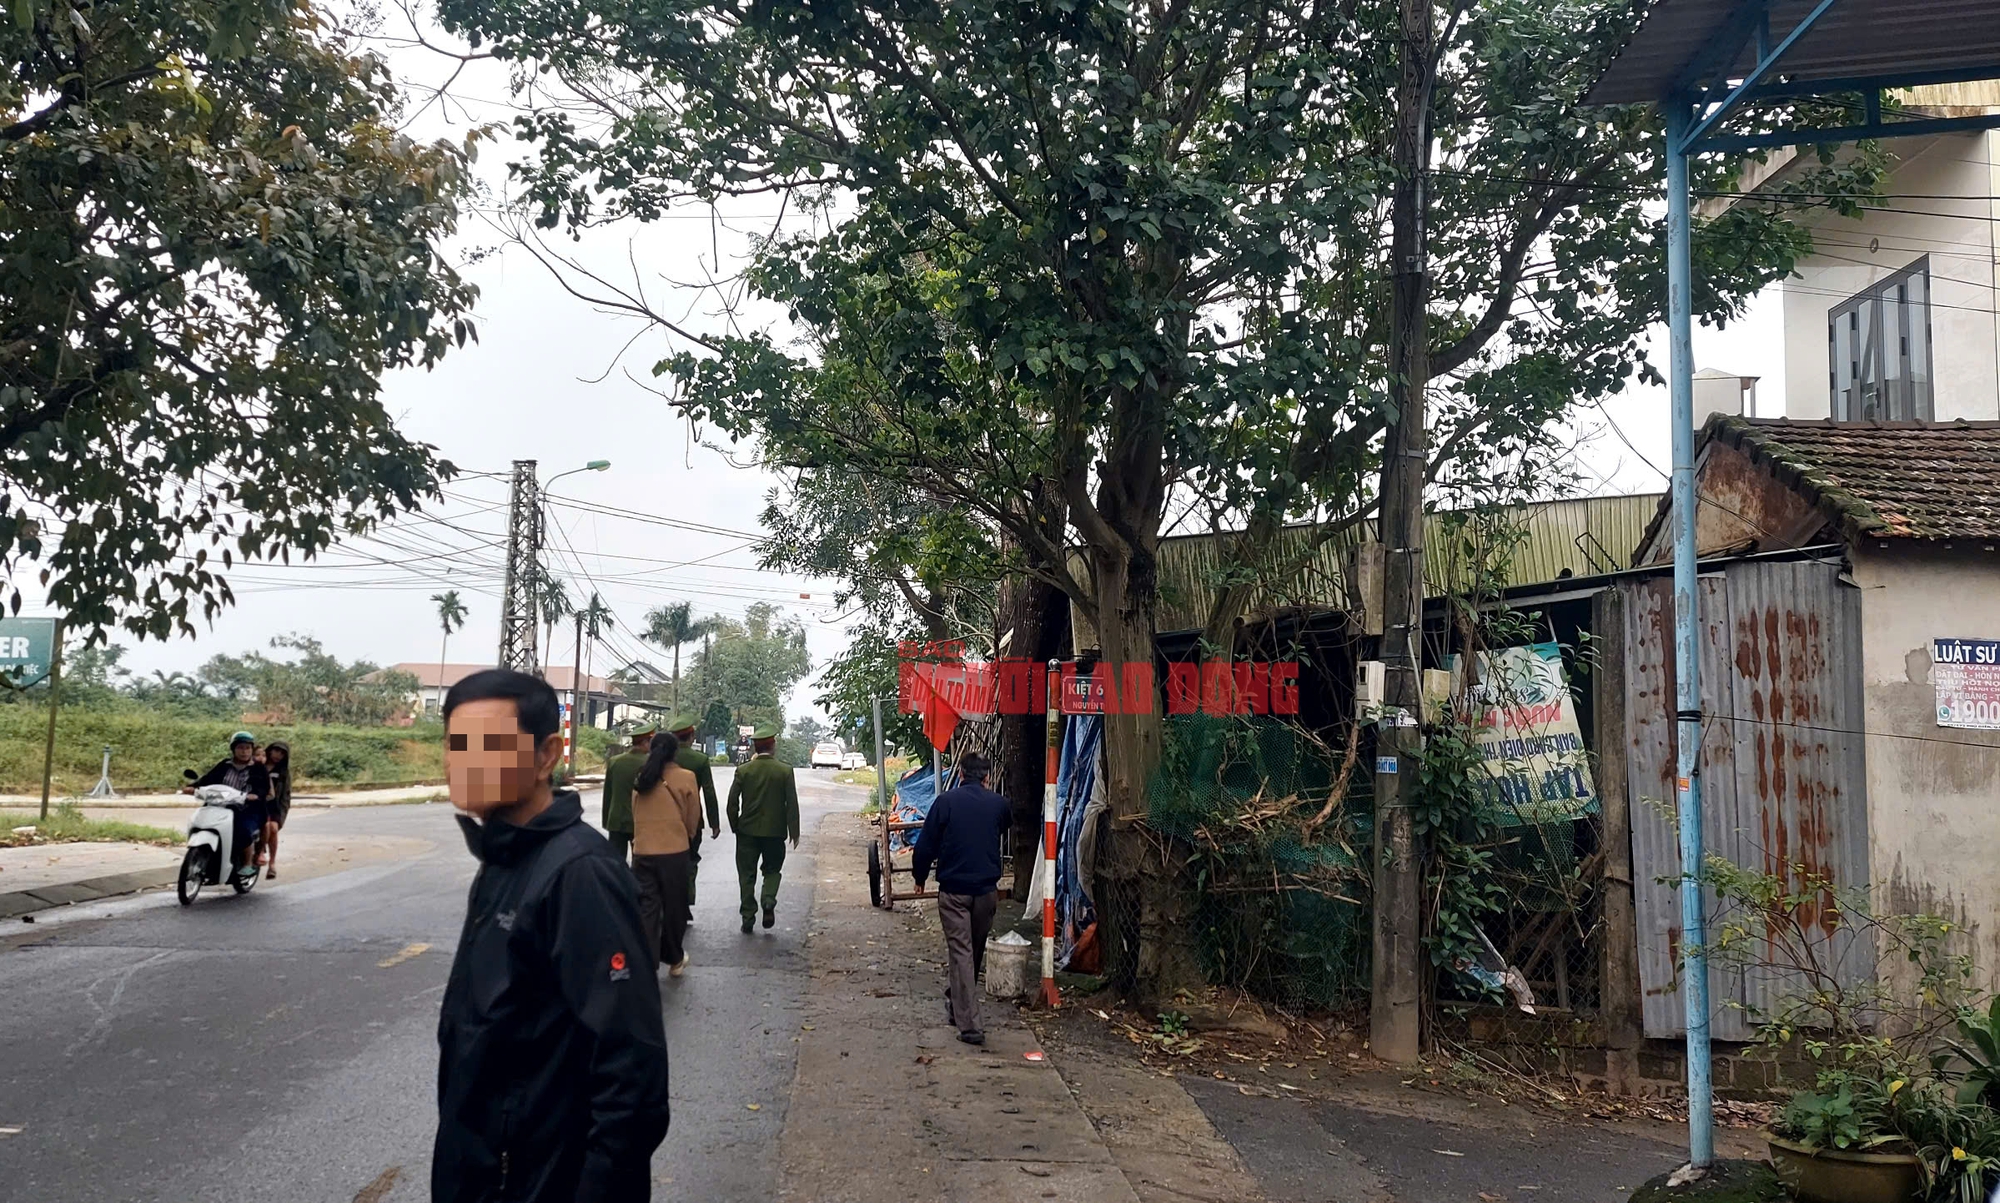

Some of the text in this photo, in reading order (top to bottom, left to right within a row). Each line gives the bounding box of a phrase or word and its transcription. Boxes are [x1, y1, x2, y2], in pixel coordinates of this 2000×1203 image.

[1935, 639, 1998, 665] LUẬT SƯ
[947, 677, 988, 714] TRÀM
[1068, 681, 1093, 698] KIỆT
[1072, 699, 1099, 710] NGUYỄN
[1950, 699, 2000, 724] 1900
